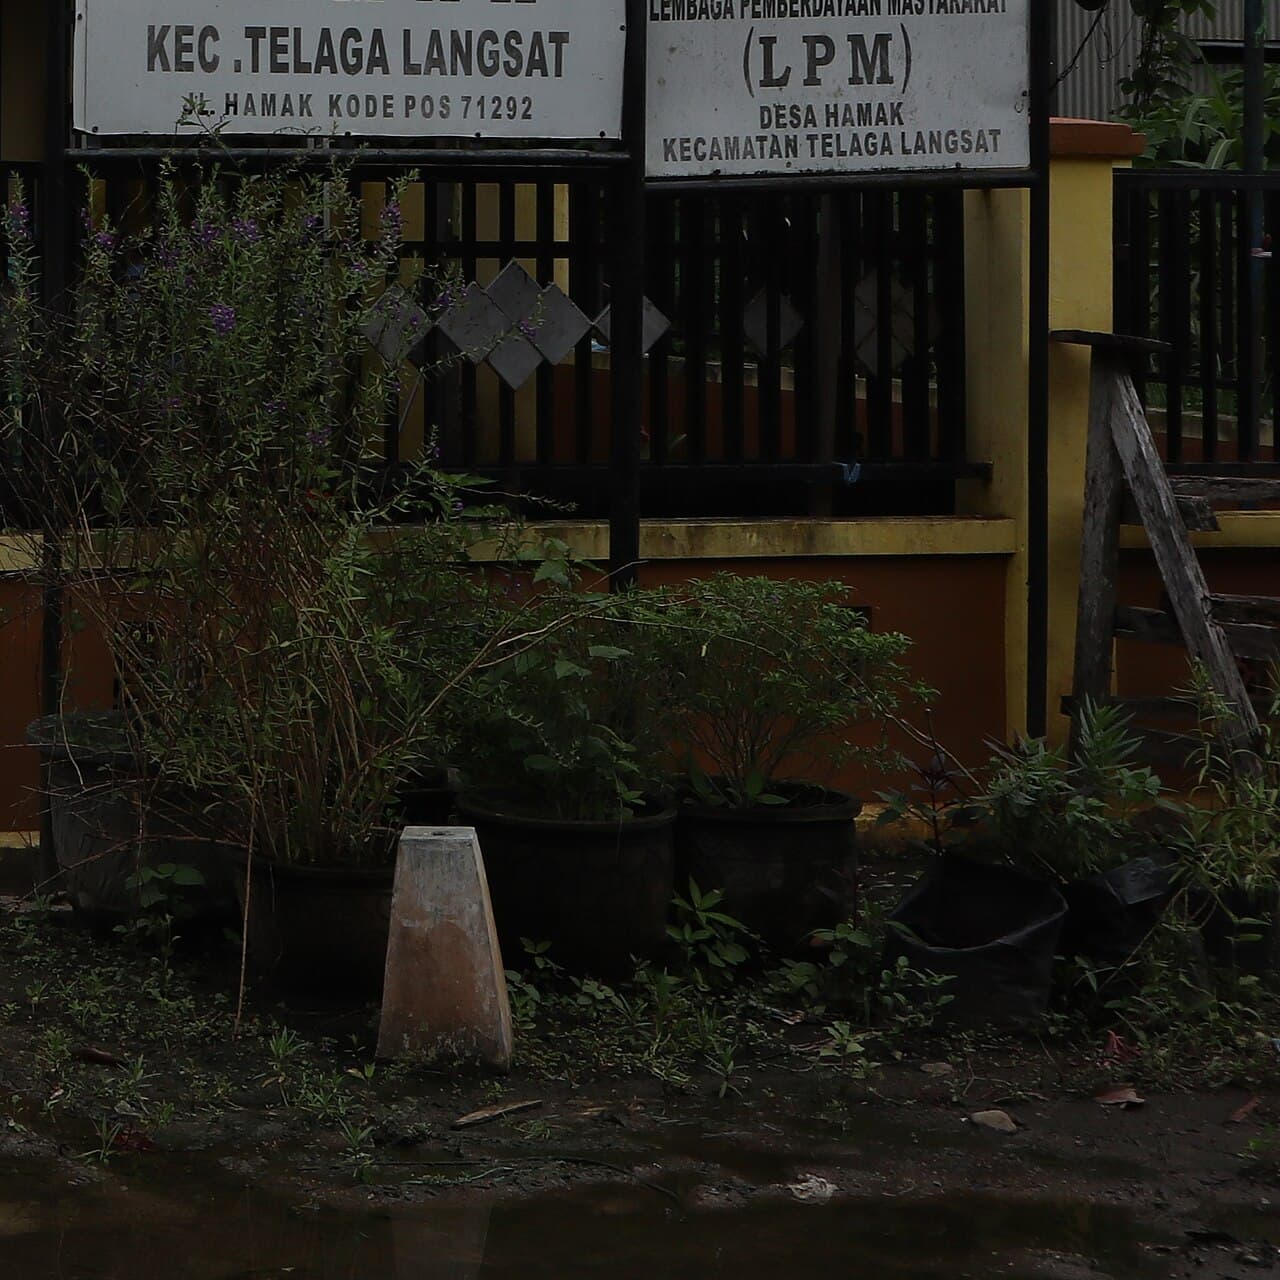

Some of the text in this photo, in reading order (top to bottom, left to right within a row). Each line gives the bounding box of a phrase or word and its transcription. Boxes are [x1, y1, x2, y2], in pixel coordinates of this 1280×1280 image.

[403, 29, 569, 77] LANGSAT
[225, 93, 312, 118] HAMAK
[329, 94, 393, 117] KODE
[405, 95, 449, 118] POS
[462, 96, 531, 119] 71292
[760, 102, 904, 129] DESA HAMAK
[663, 128, 1000, 163] KECAMATAN TELAGA LANGSAT
